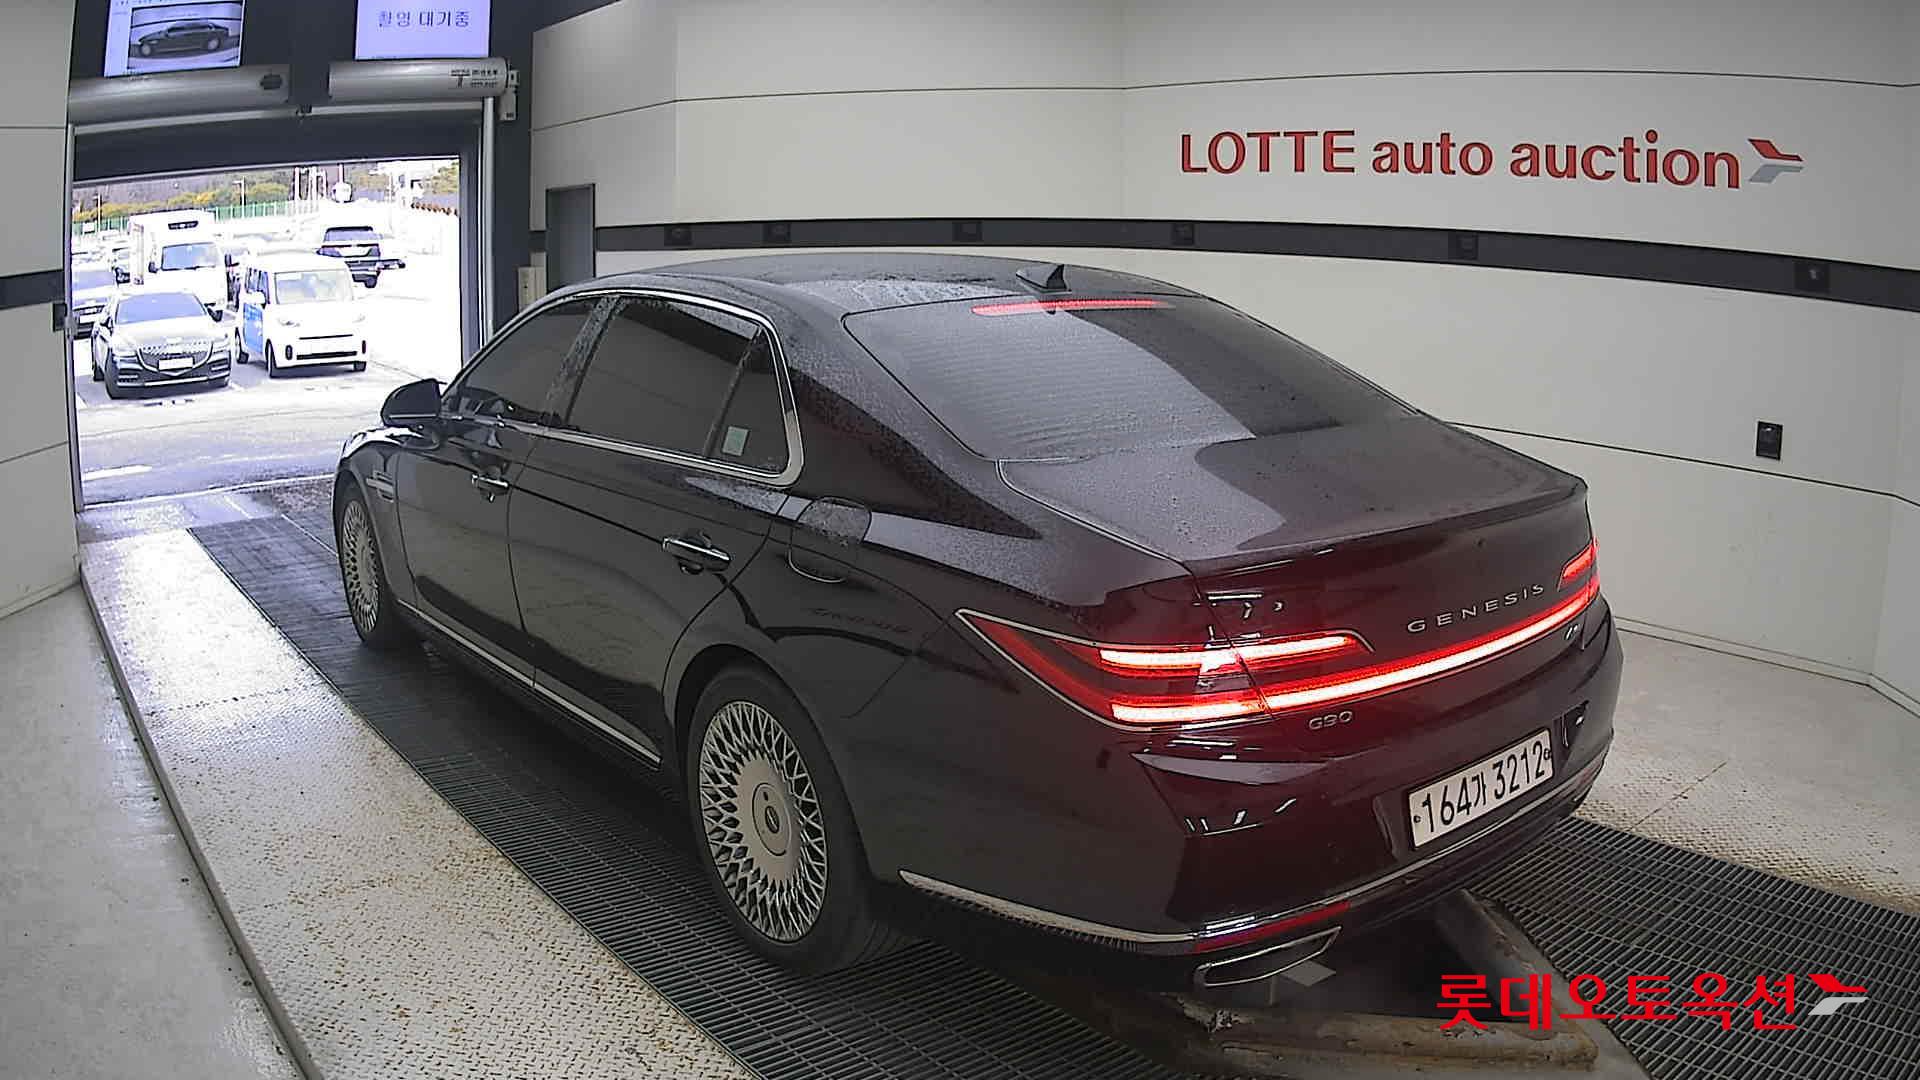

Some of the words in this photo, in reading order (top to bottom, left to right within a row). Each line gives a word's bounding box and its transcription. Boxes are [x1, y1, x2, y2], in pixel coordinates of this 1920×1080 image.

[419, 10, 469, 27] 대기중
[1181, 130, 1356, 174] LOTTE
[1372, 132, 1494, 176] auto
[1509, 130, 1741, 189] auction
[1407, 584, 1544, 632] GENESIS
[1422, 771, 1487, 833] 164가
[1492, 741, 1545, 800] 3212
